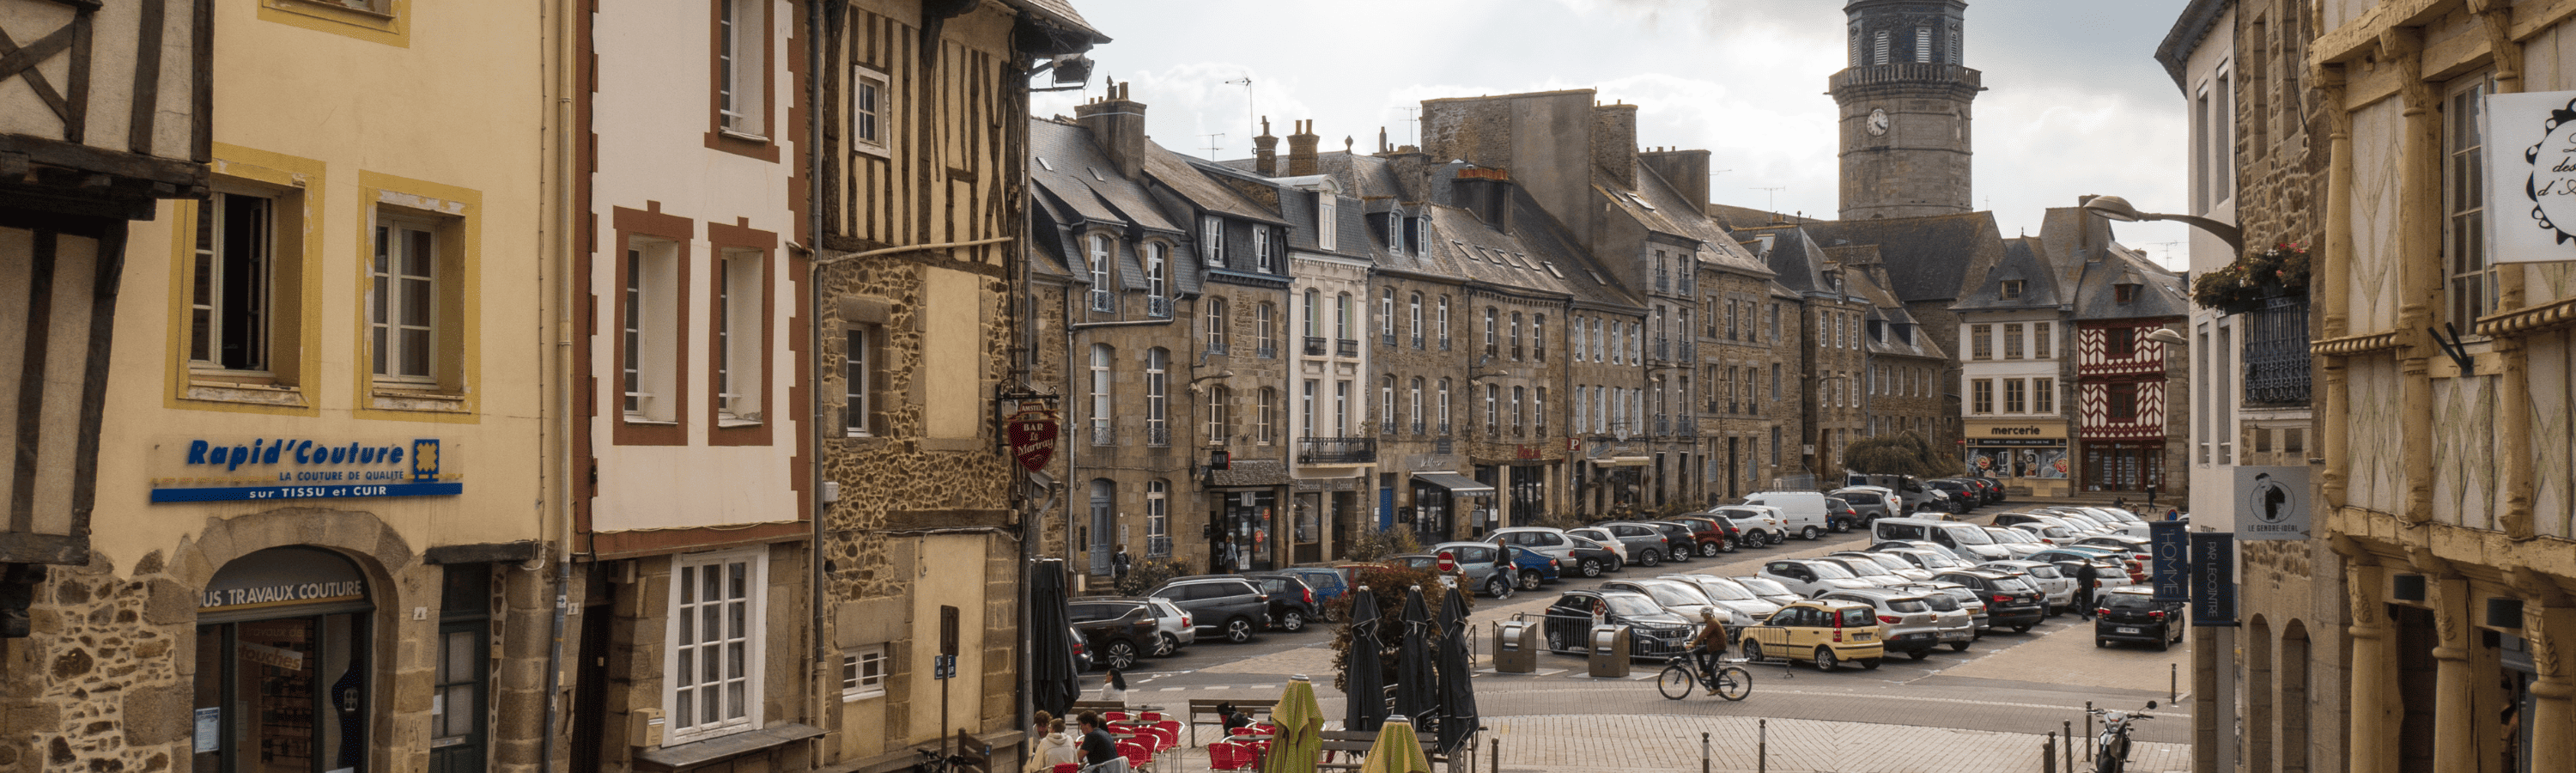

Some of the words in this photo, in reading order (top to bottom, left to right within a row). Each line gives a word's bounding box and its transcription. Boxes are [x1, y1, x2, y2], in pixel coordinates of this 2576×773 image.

[1024, 423, 1043, 431] BAR
[1991, 425, 2040, 435] mercerie
[1030, 432, 1039, 441] Le
[1017, 438, 1054, 456] Martray
[1571, 439, 1580, 450] P
[188, 438, 404, 472] Rapid'Couture
[279, 472, 292, 481] LA
[297, 472, 343, 481] COUTURE
[348, 471, 361, 480] DE
[365, 469, 404, 481] QUALITÉ
[1336, 481, 1353, 490] Optique
[282, 488, 325, 497] TISSU
[353, 486, 386, 496] CUIR
[2207, 541, 2217, 560] PAR
[200, 590, 222, 607] US
[228, 584, 295, 605] TRAVAUX
[299, 580, 361, 600] COUTURE
[2207, 563, 2218, 618] LECOINTRE
